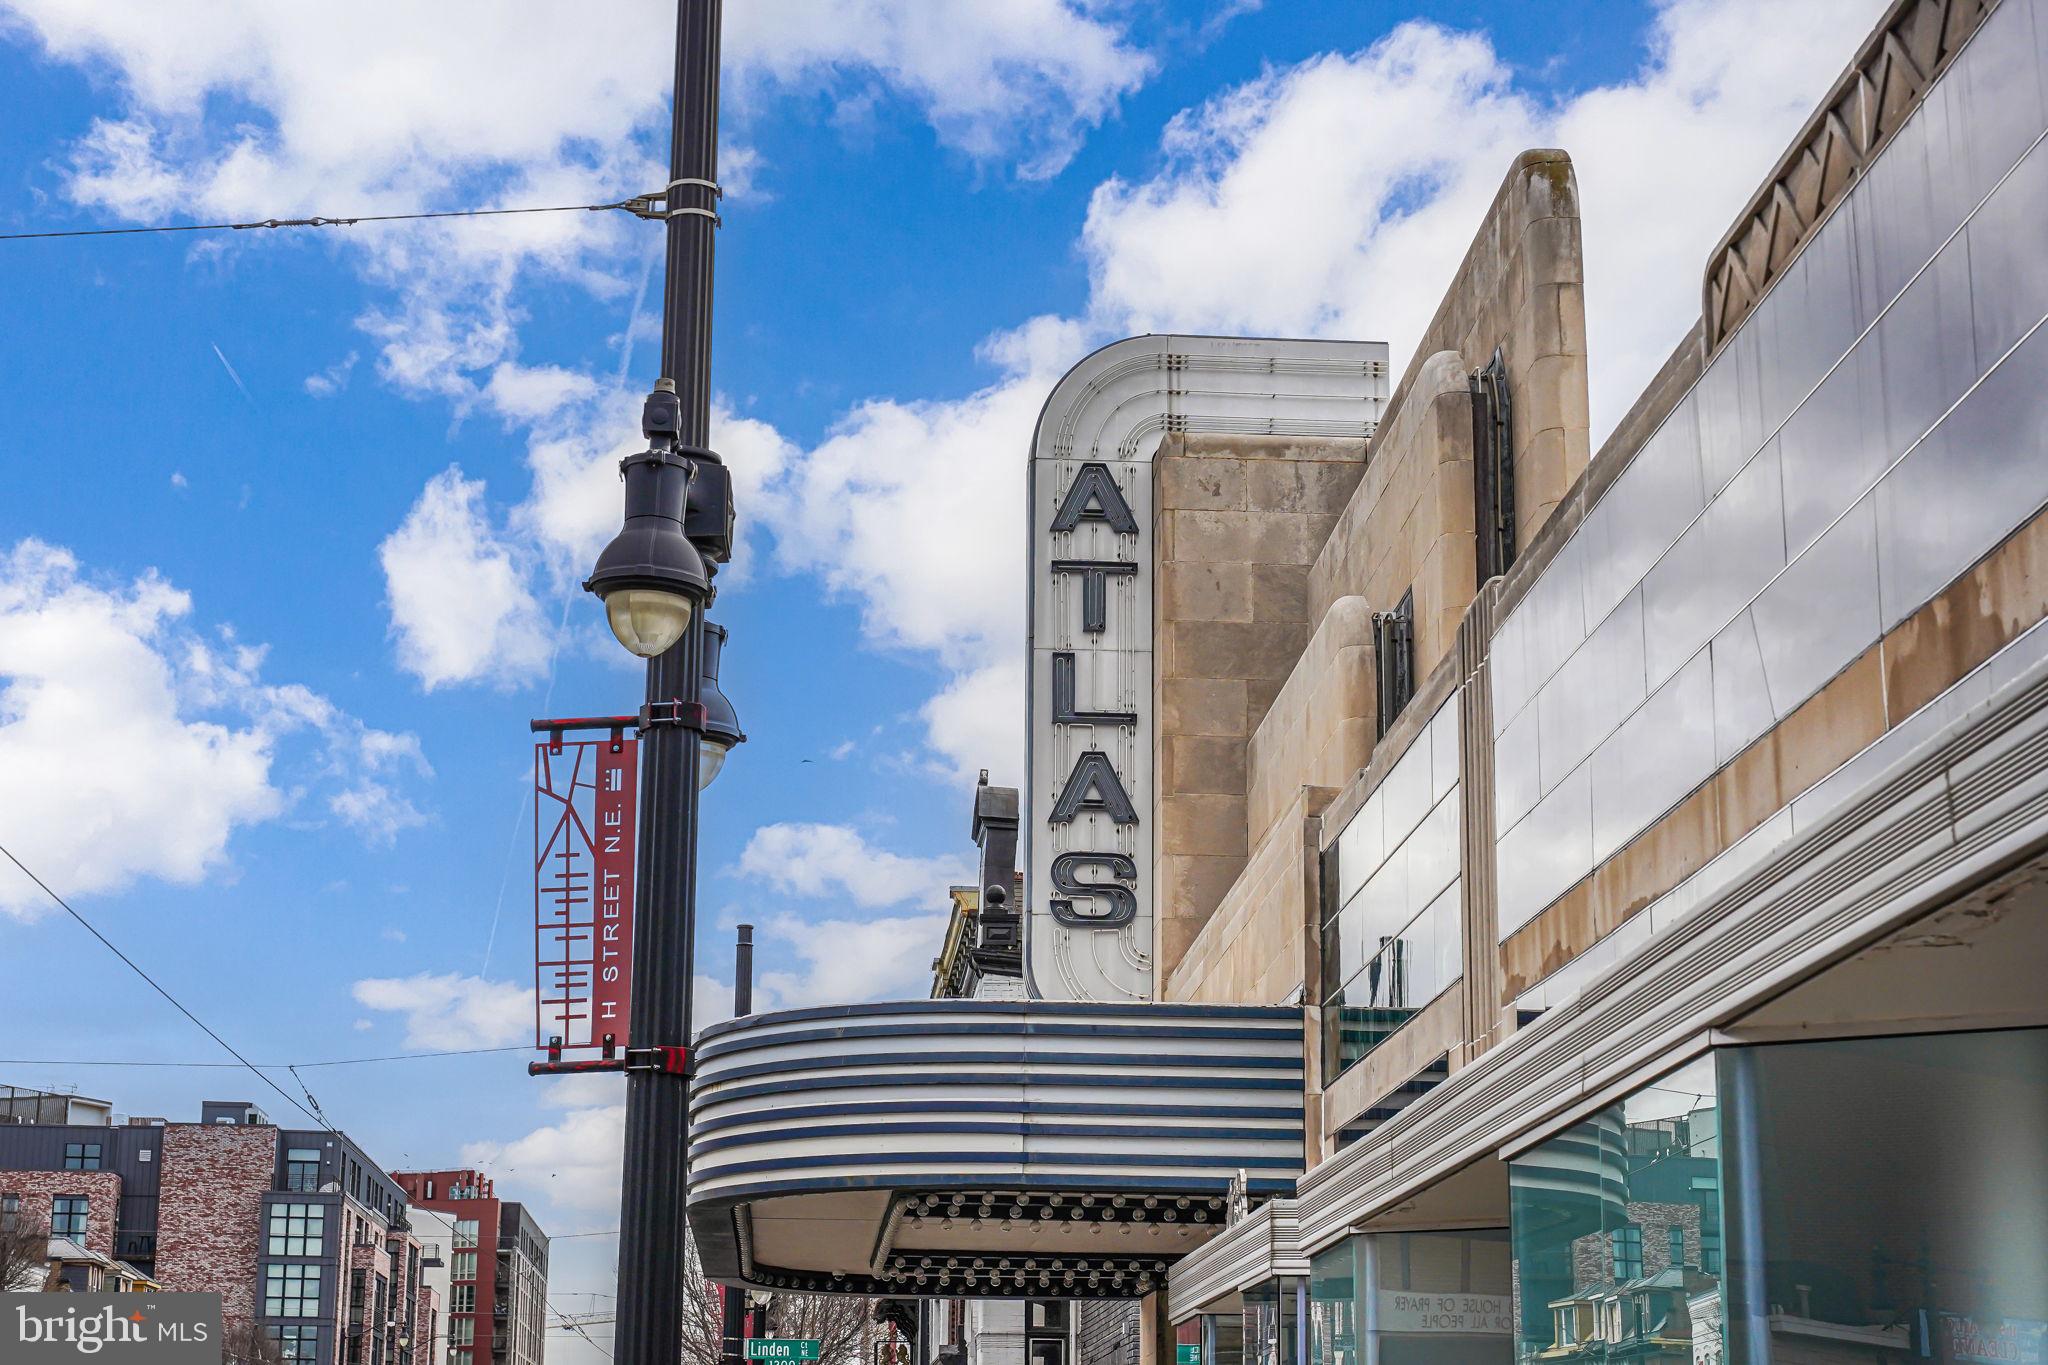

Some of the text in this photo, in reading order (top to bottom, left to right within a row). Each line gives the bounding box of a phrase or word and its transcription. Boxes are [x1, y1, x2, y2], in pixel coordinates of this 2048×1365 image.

[1048, 462, 1139, 929] ATLAS
[602, 804, 621, 1019] H STREET N.E.
[751, 1341, 790, 1356] Linden
